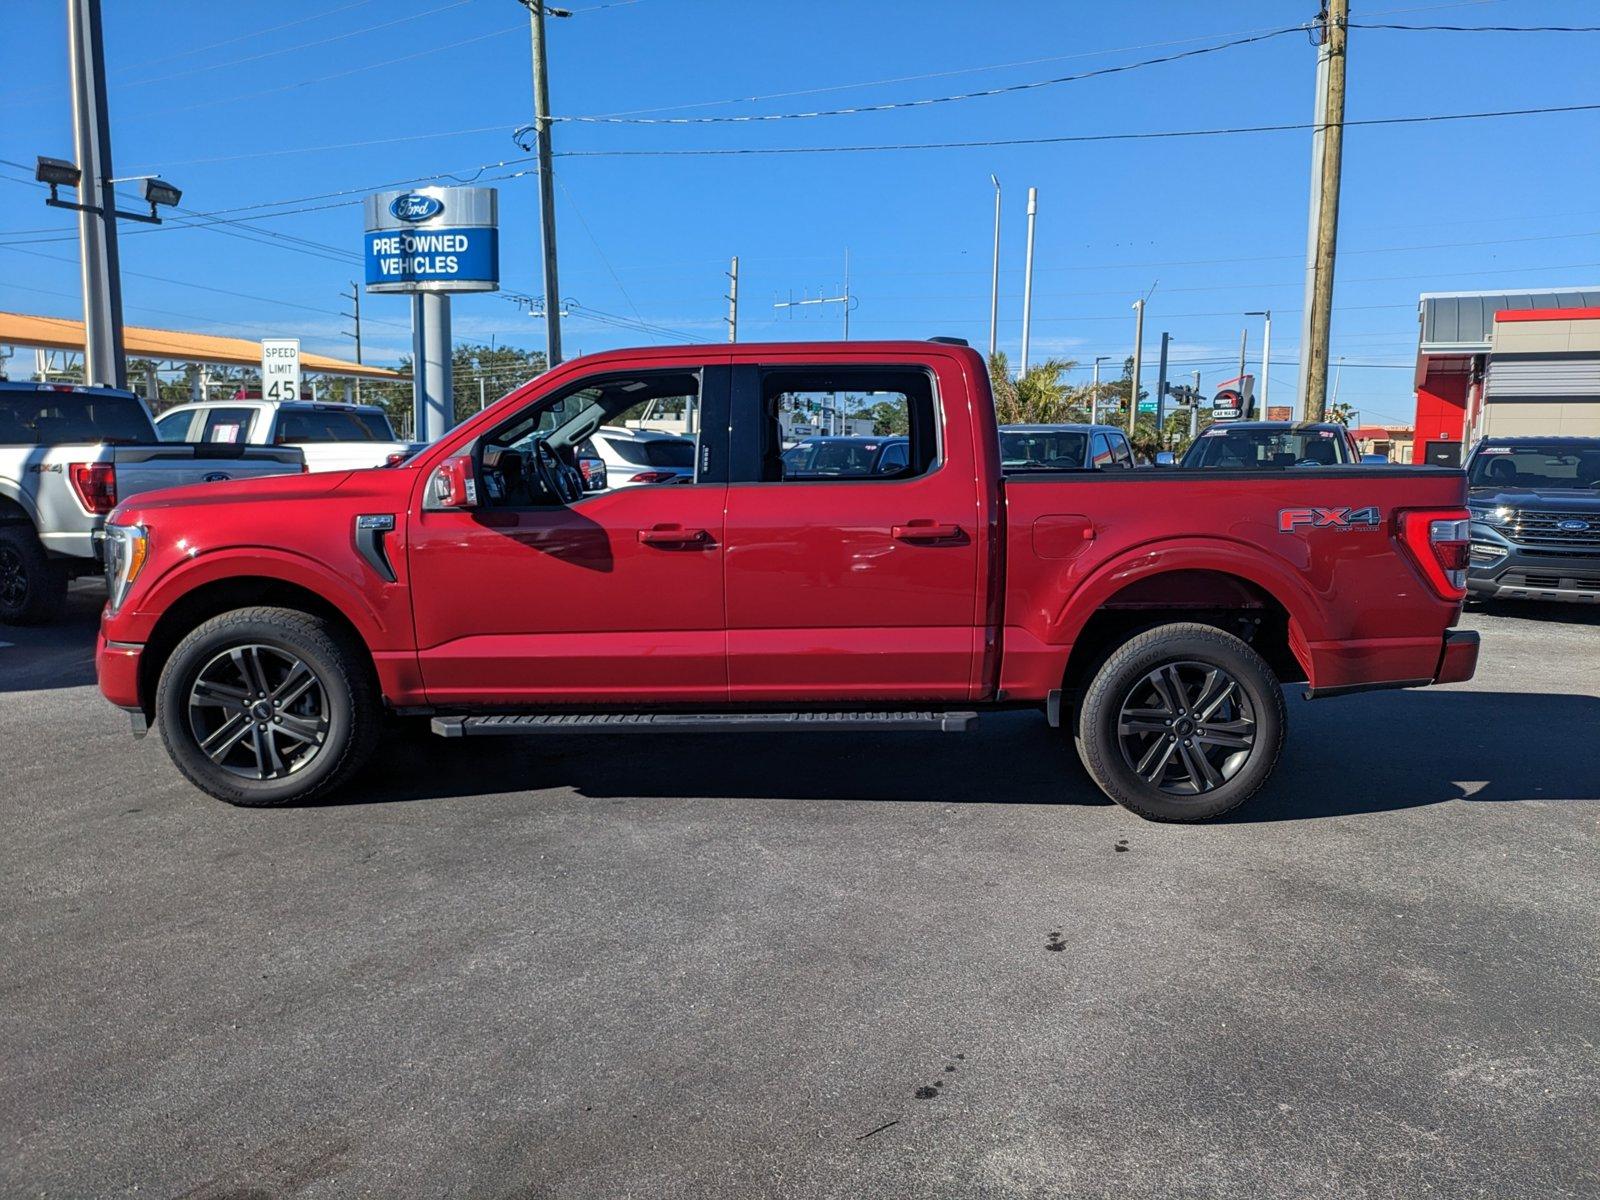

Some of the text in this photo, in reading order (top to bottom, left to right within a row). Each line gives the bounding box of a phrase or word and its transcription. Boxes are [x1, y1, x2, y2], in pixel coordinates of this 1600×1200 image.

[398, 197, 429, 216] Ford
[373, 235, 469, 256] PRE-OWNED
[380, 256, 459, 275] VEHICLES
[265, 347, 296, 358] SPEED
[268, 364, 292, 374] LIMIT
[267, 380, 295, 401] 45
[1279, 506, 1382, 534] FX4
